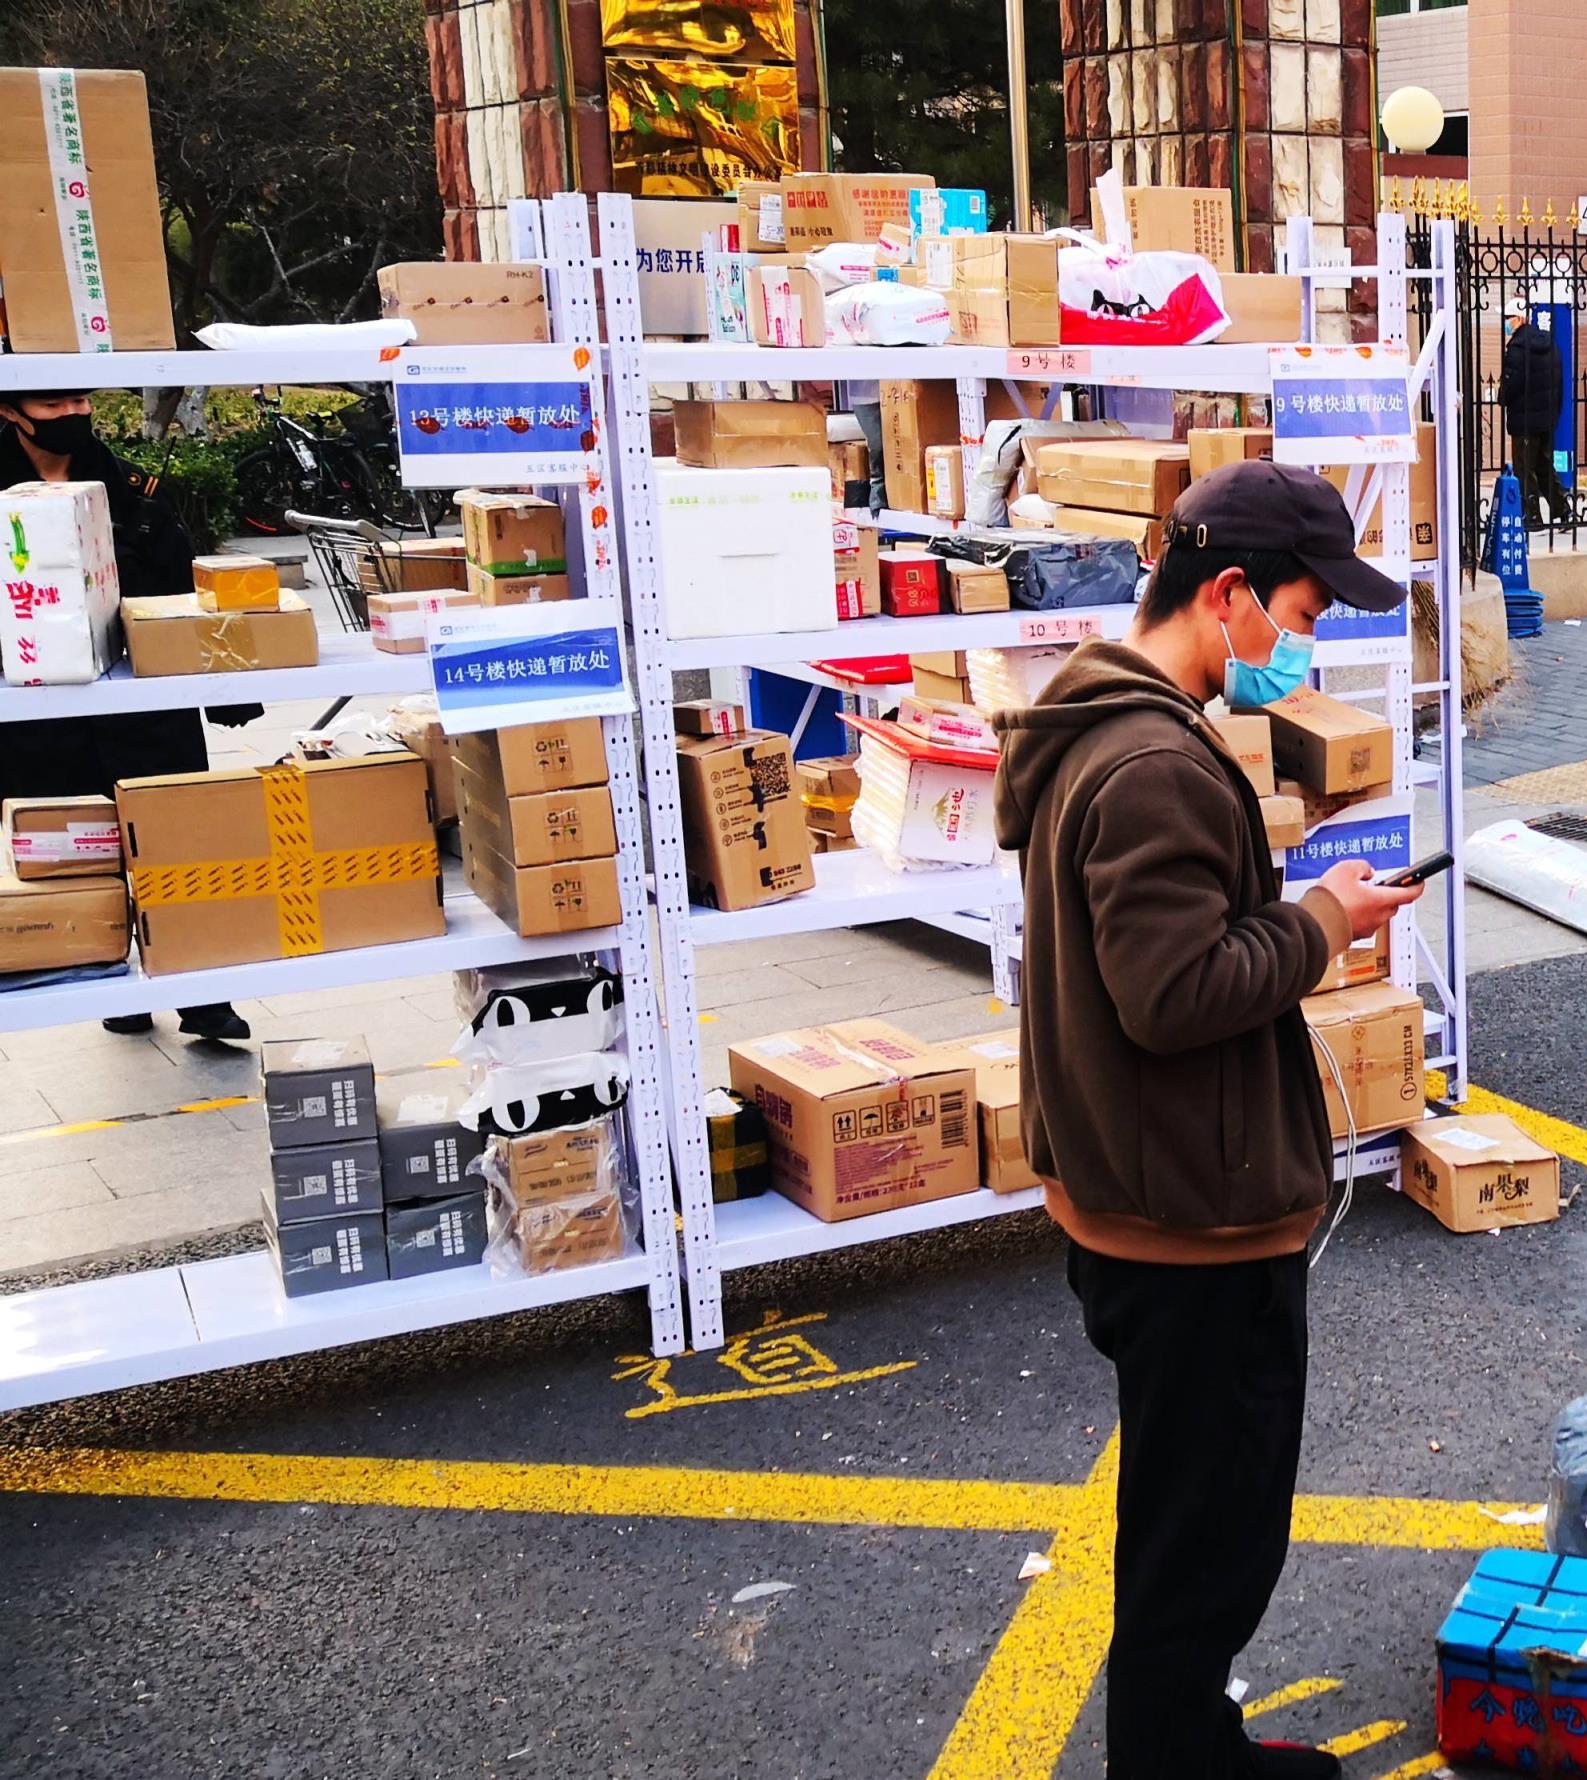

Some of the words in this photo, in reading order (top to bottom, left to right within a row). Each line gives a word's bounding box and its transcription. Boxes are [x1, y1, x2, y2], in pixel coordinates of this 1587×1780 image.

[75, 208, 104, 300] 陕西省著名商标
[408, 404, 580, 427] 13号楼快递暂放处
[1276, 392, 1404, 414] 9号楼快递暂放处
[444, 649, 611, 684] 14号楼快递暂放处
[1292, 832, 1404, 861] 11号楼快递暂放处
[1478, 1173, 1530, 1205] 南果梨
